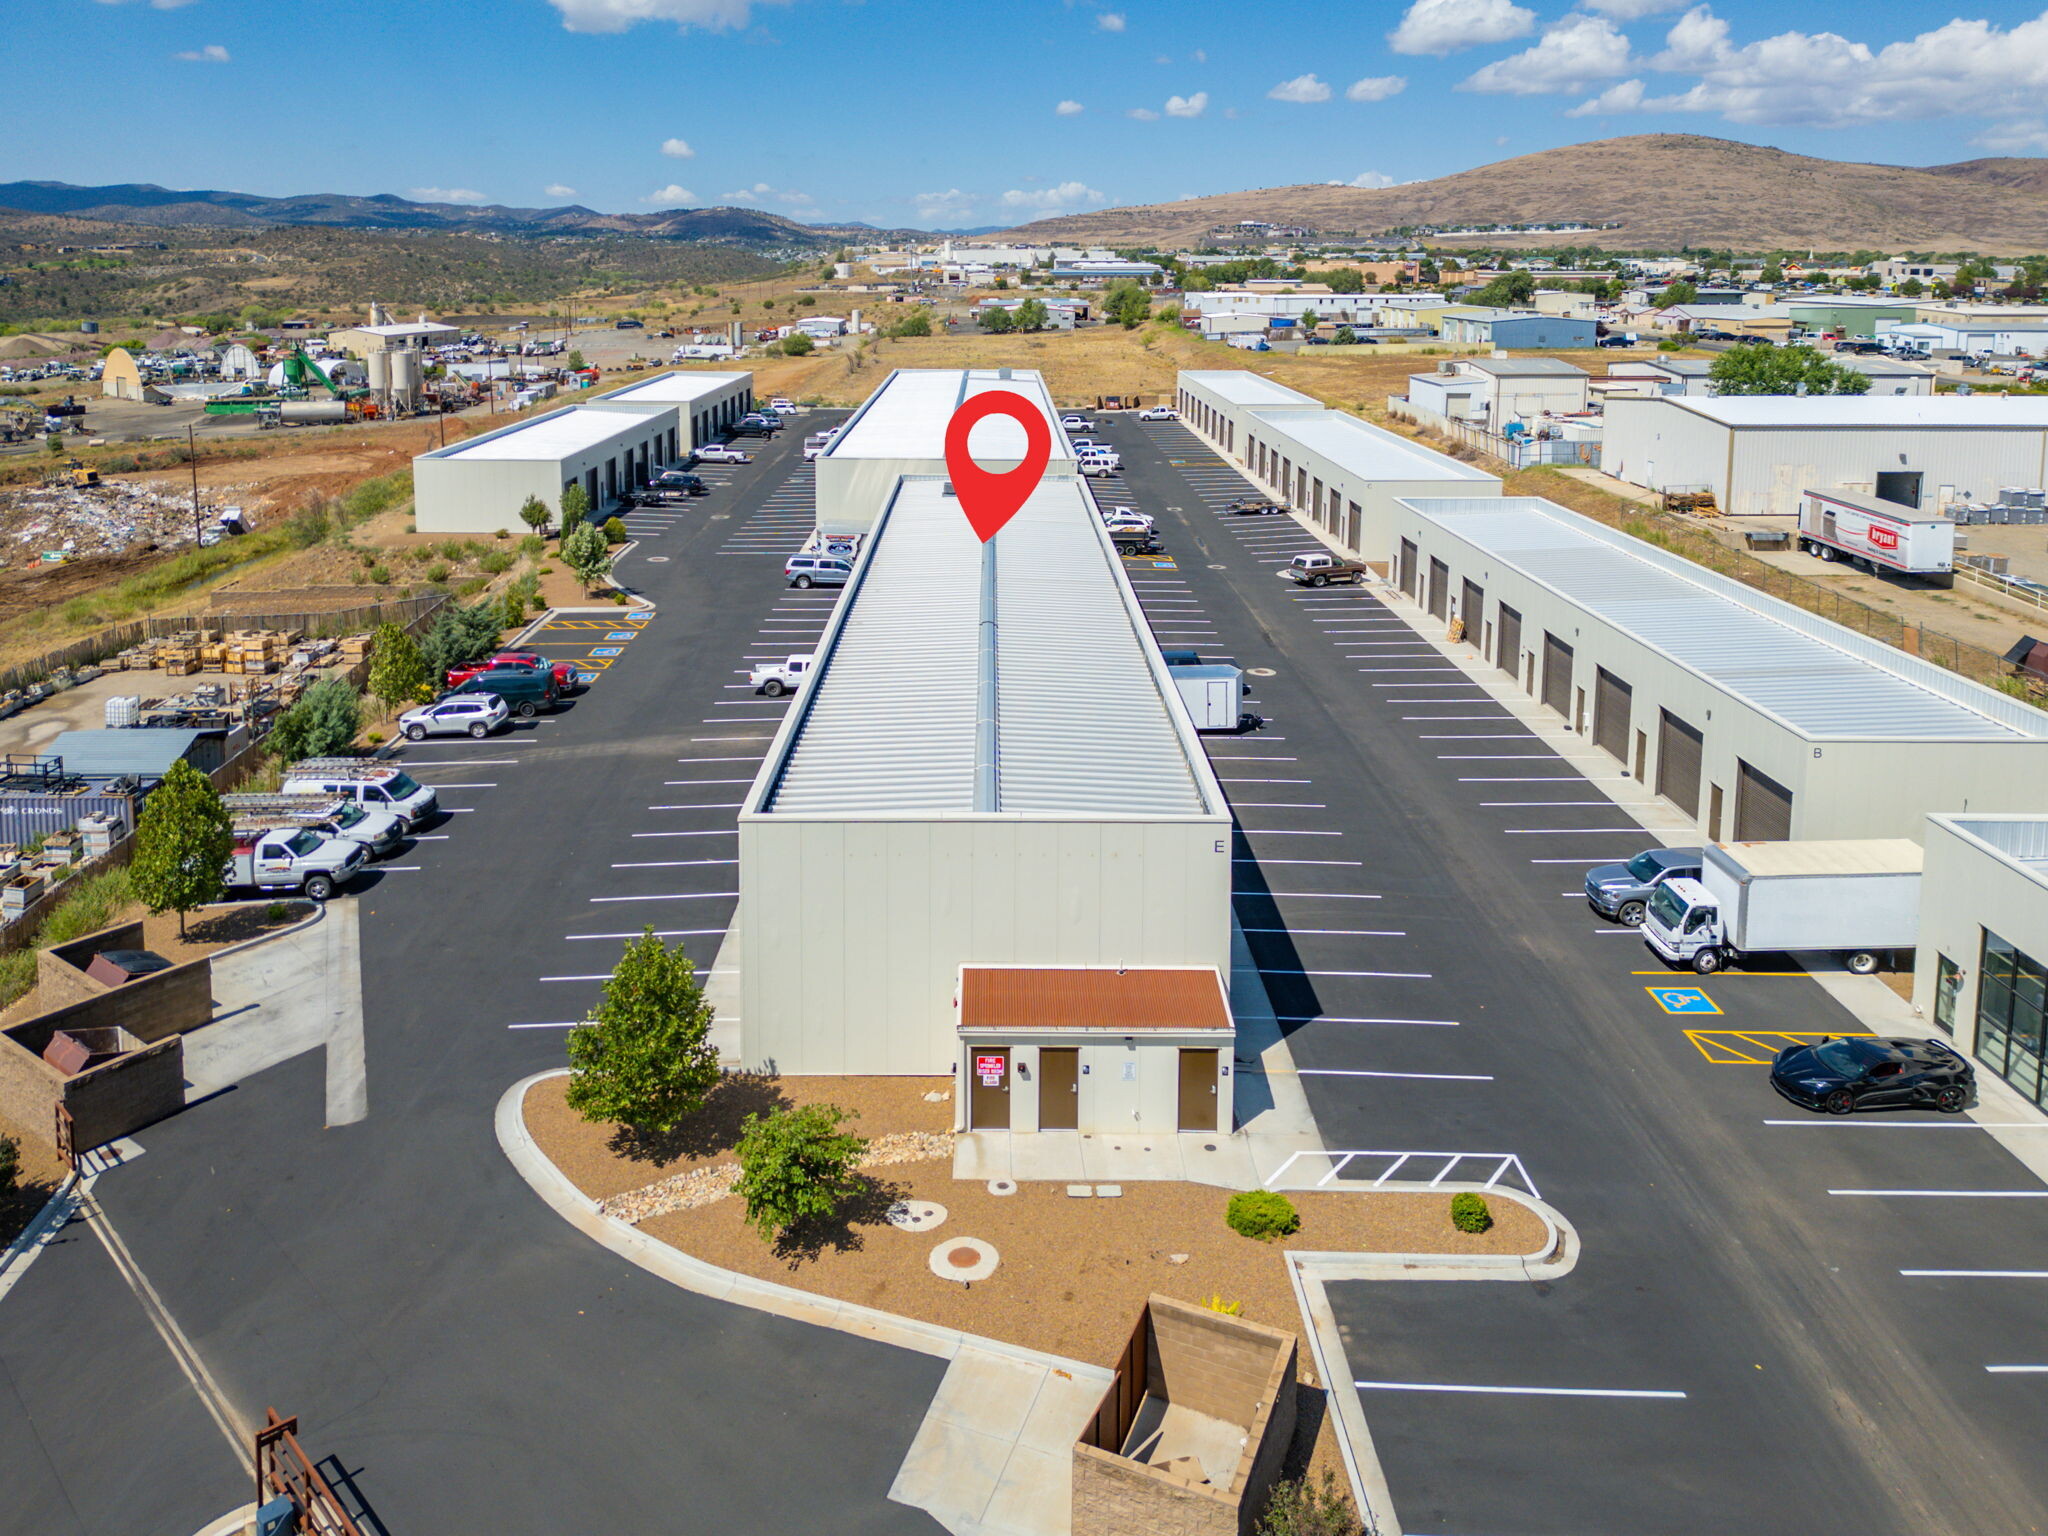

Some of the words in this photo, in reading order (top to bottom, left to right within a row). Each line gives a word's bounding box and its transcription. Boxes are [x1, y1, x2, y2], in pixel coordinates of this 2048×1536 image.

[1871, 527, 1895, 546] bryant
[1813, 747, 1822, 758] B
[21, 807, 63, 815] CRONOS
[1214, 840, 1224, 853] E
